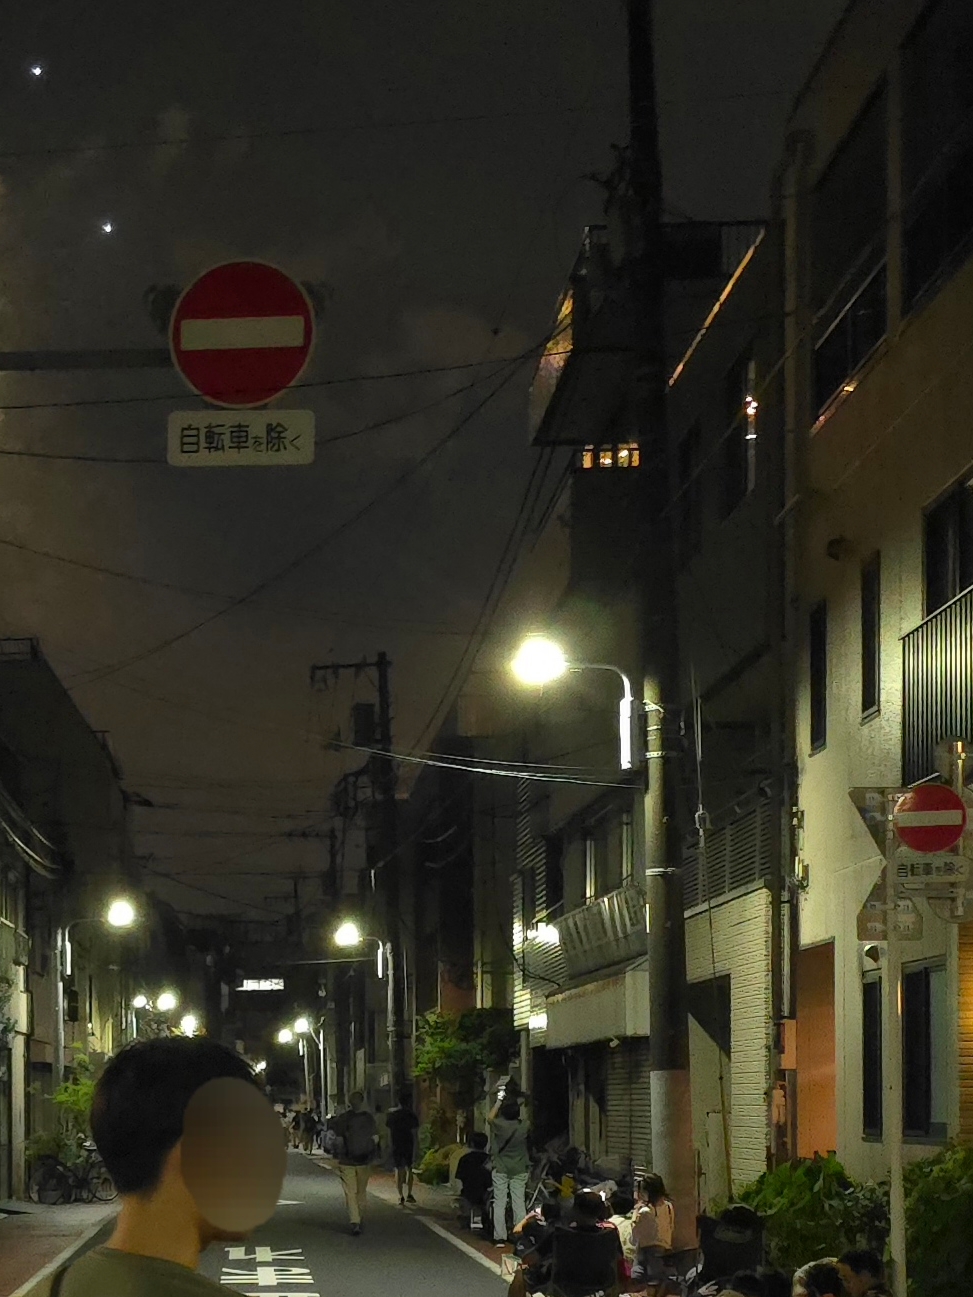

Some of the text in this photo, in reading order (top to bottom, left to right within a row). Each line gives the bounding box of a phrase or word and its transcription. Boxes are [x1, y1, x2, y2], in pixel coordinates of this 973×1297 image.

[180, 422, 301, 454] 自転車を除く
